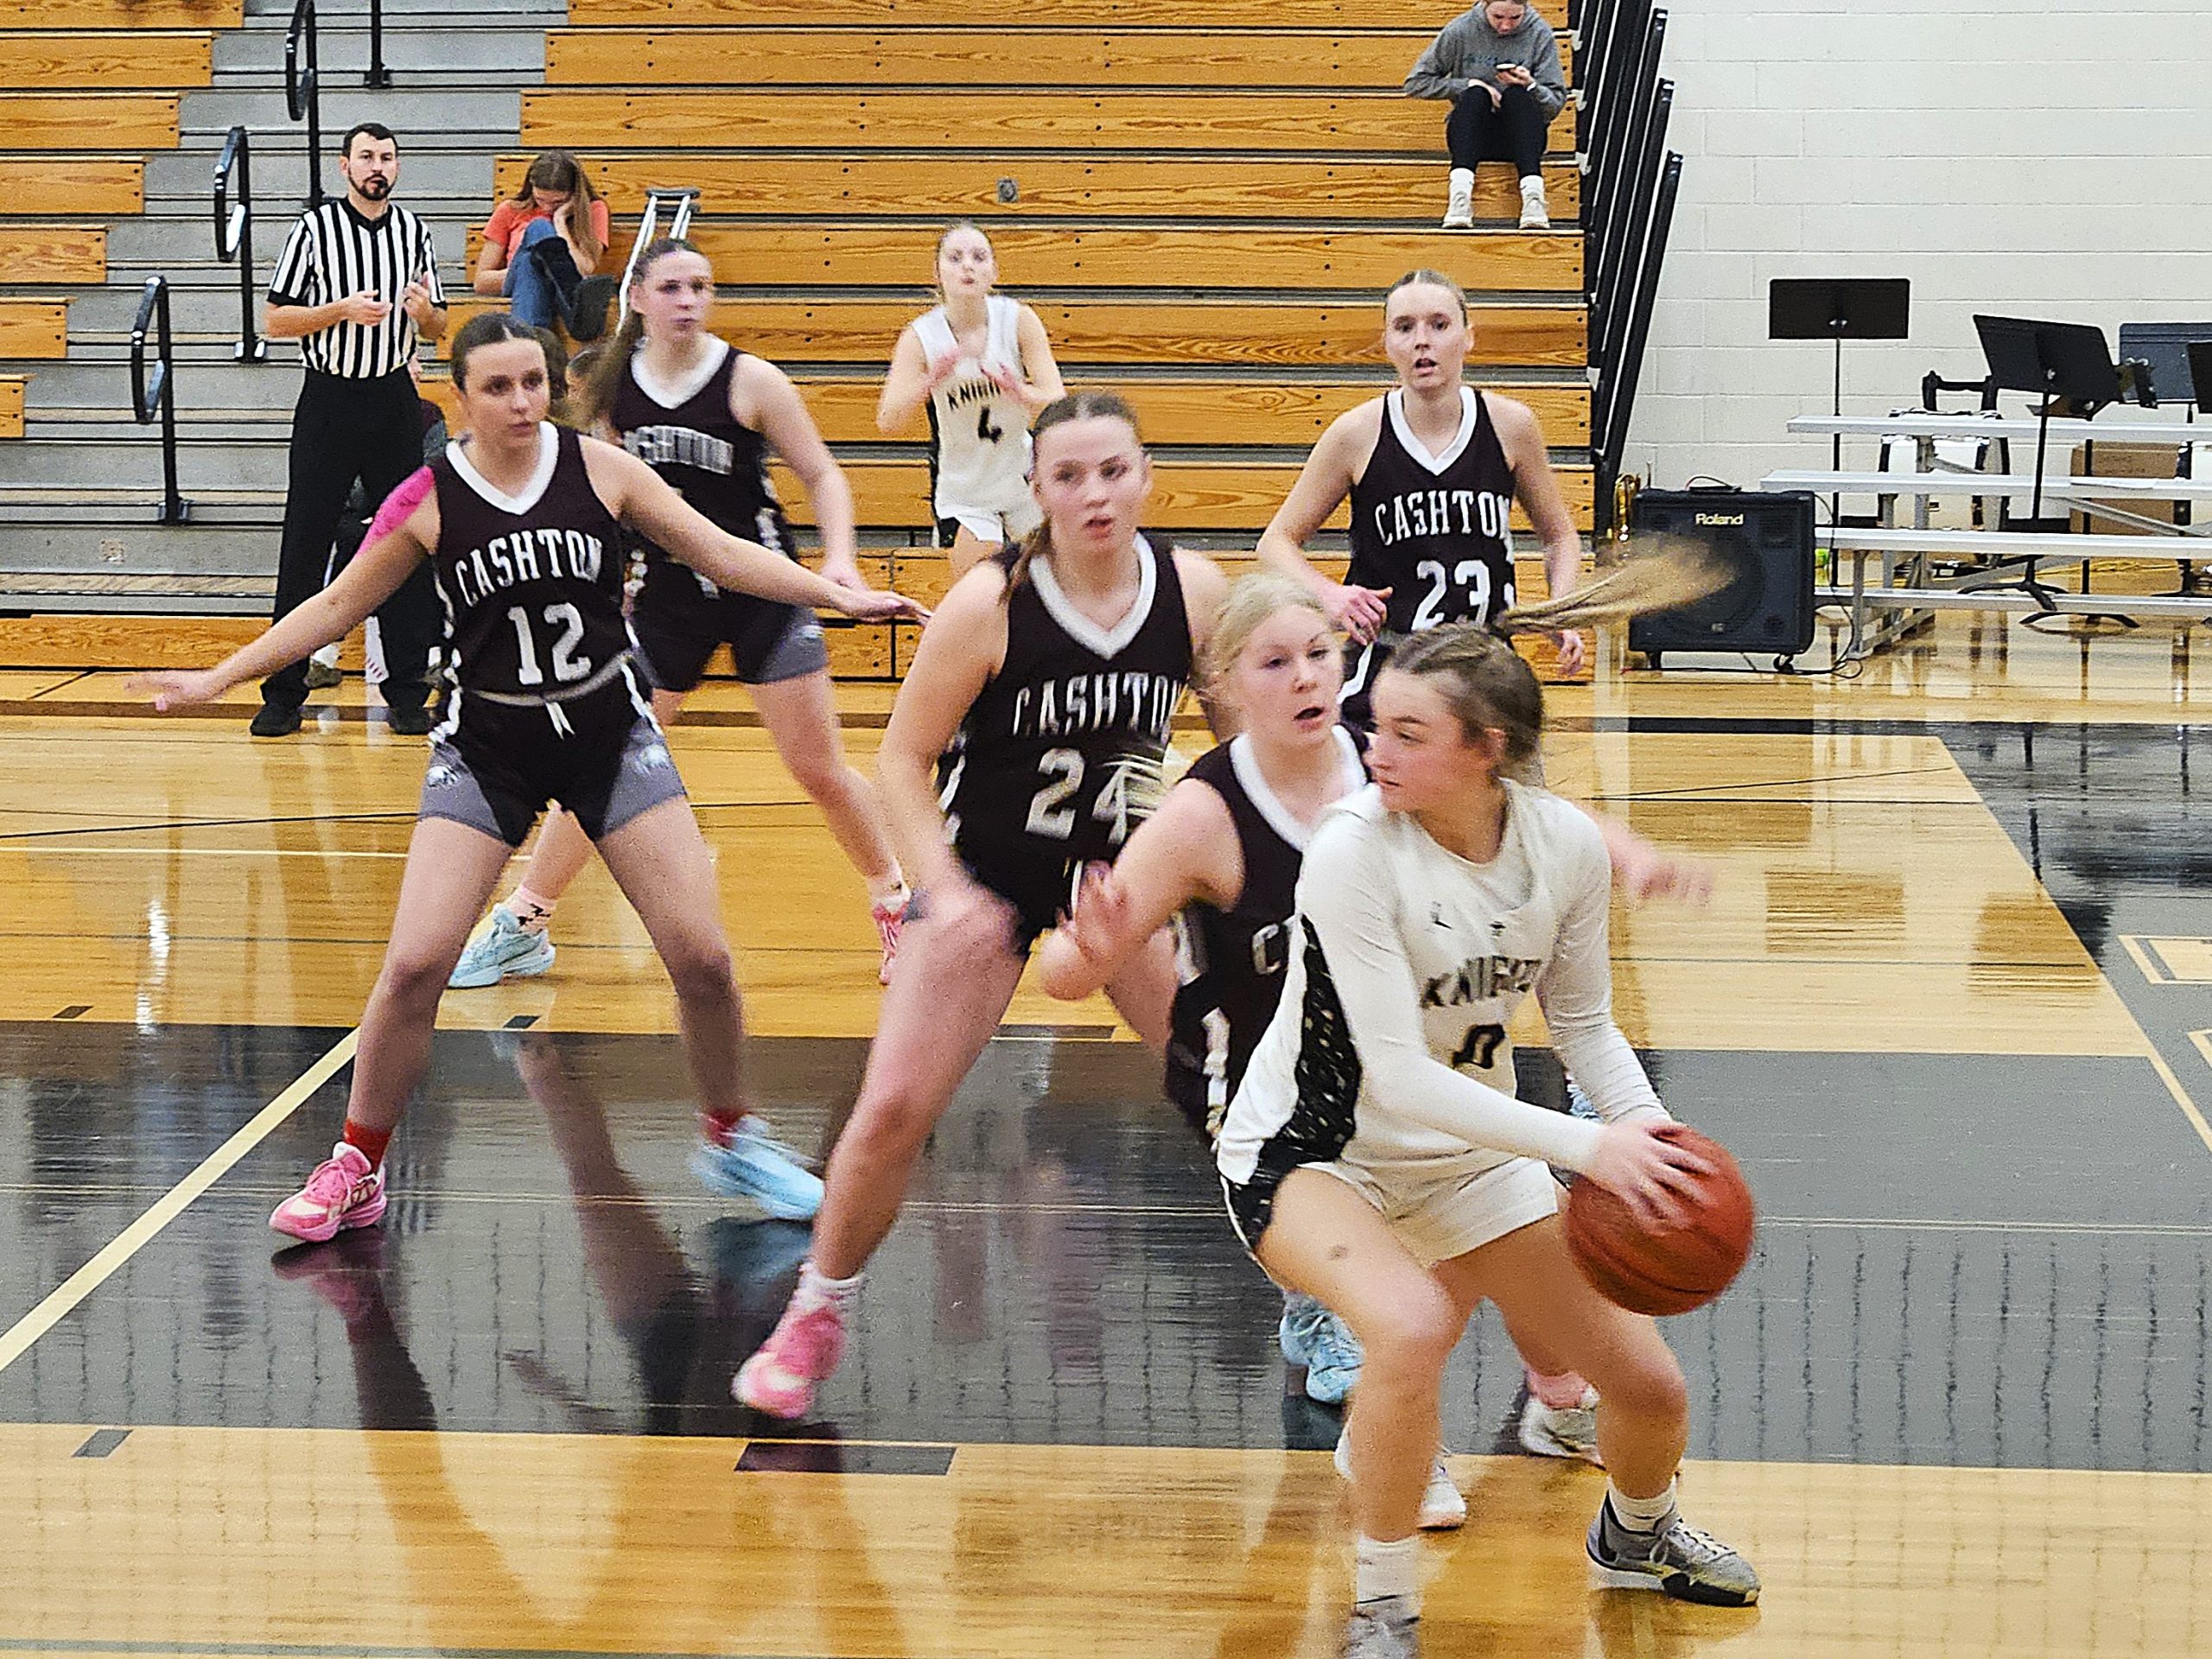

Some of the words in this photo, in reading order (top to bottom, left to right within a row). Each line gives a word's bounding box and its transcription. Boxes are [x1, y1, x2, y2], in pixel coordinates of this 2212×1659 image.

[1695, 512, 1744, 525] Roland
[1411, 560, 1491, 630] 23
[507, 602, 592, 685] 12
[1025, 747, 1128, 844] 24
